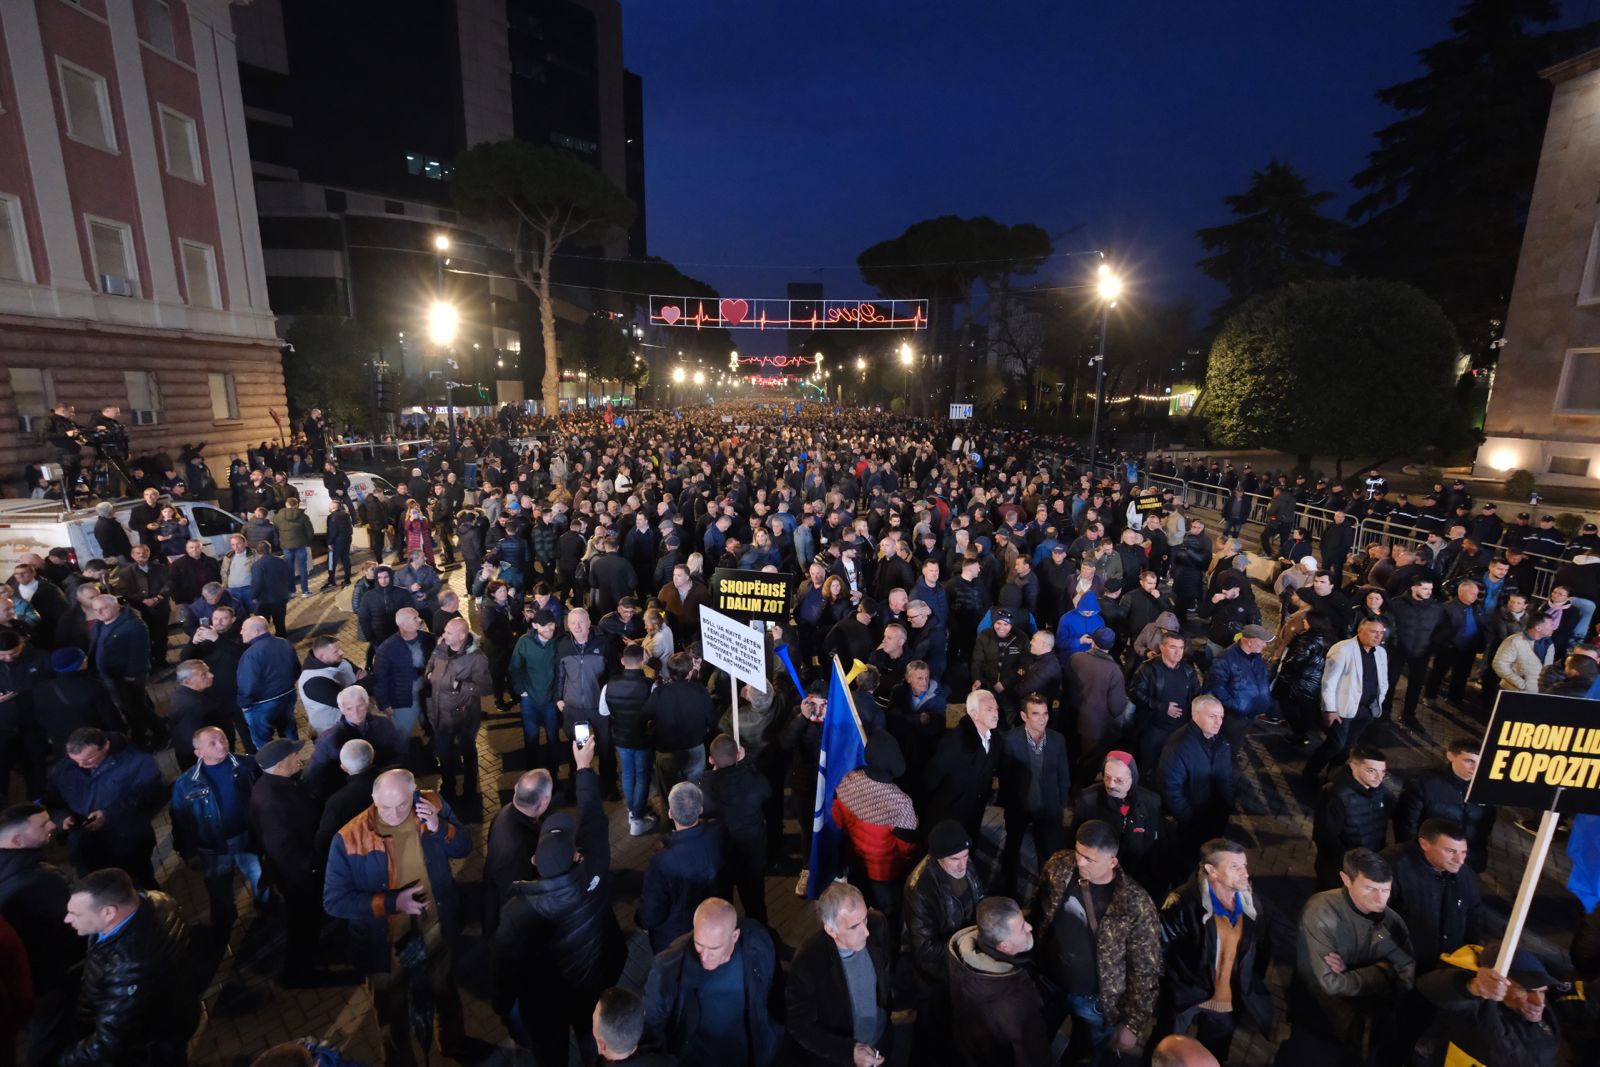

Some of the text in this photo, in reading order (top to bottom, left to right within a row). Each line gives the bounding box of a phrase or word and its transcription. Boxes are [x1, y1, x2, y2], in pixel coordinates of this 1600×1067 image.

[720, 579, 786, 598] SHQIPËRISË
[720, 596, 785, 614] I DALIM ZOT
[702, 617, 716, 629] BOLL
[735, 640, 748, 651] MOS
[1497, 721, 1574, 752] LIRONI
[1488, 749, 1511, 780] E
